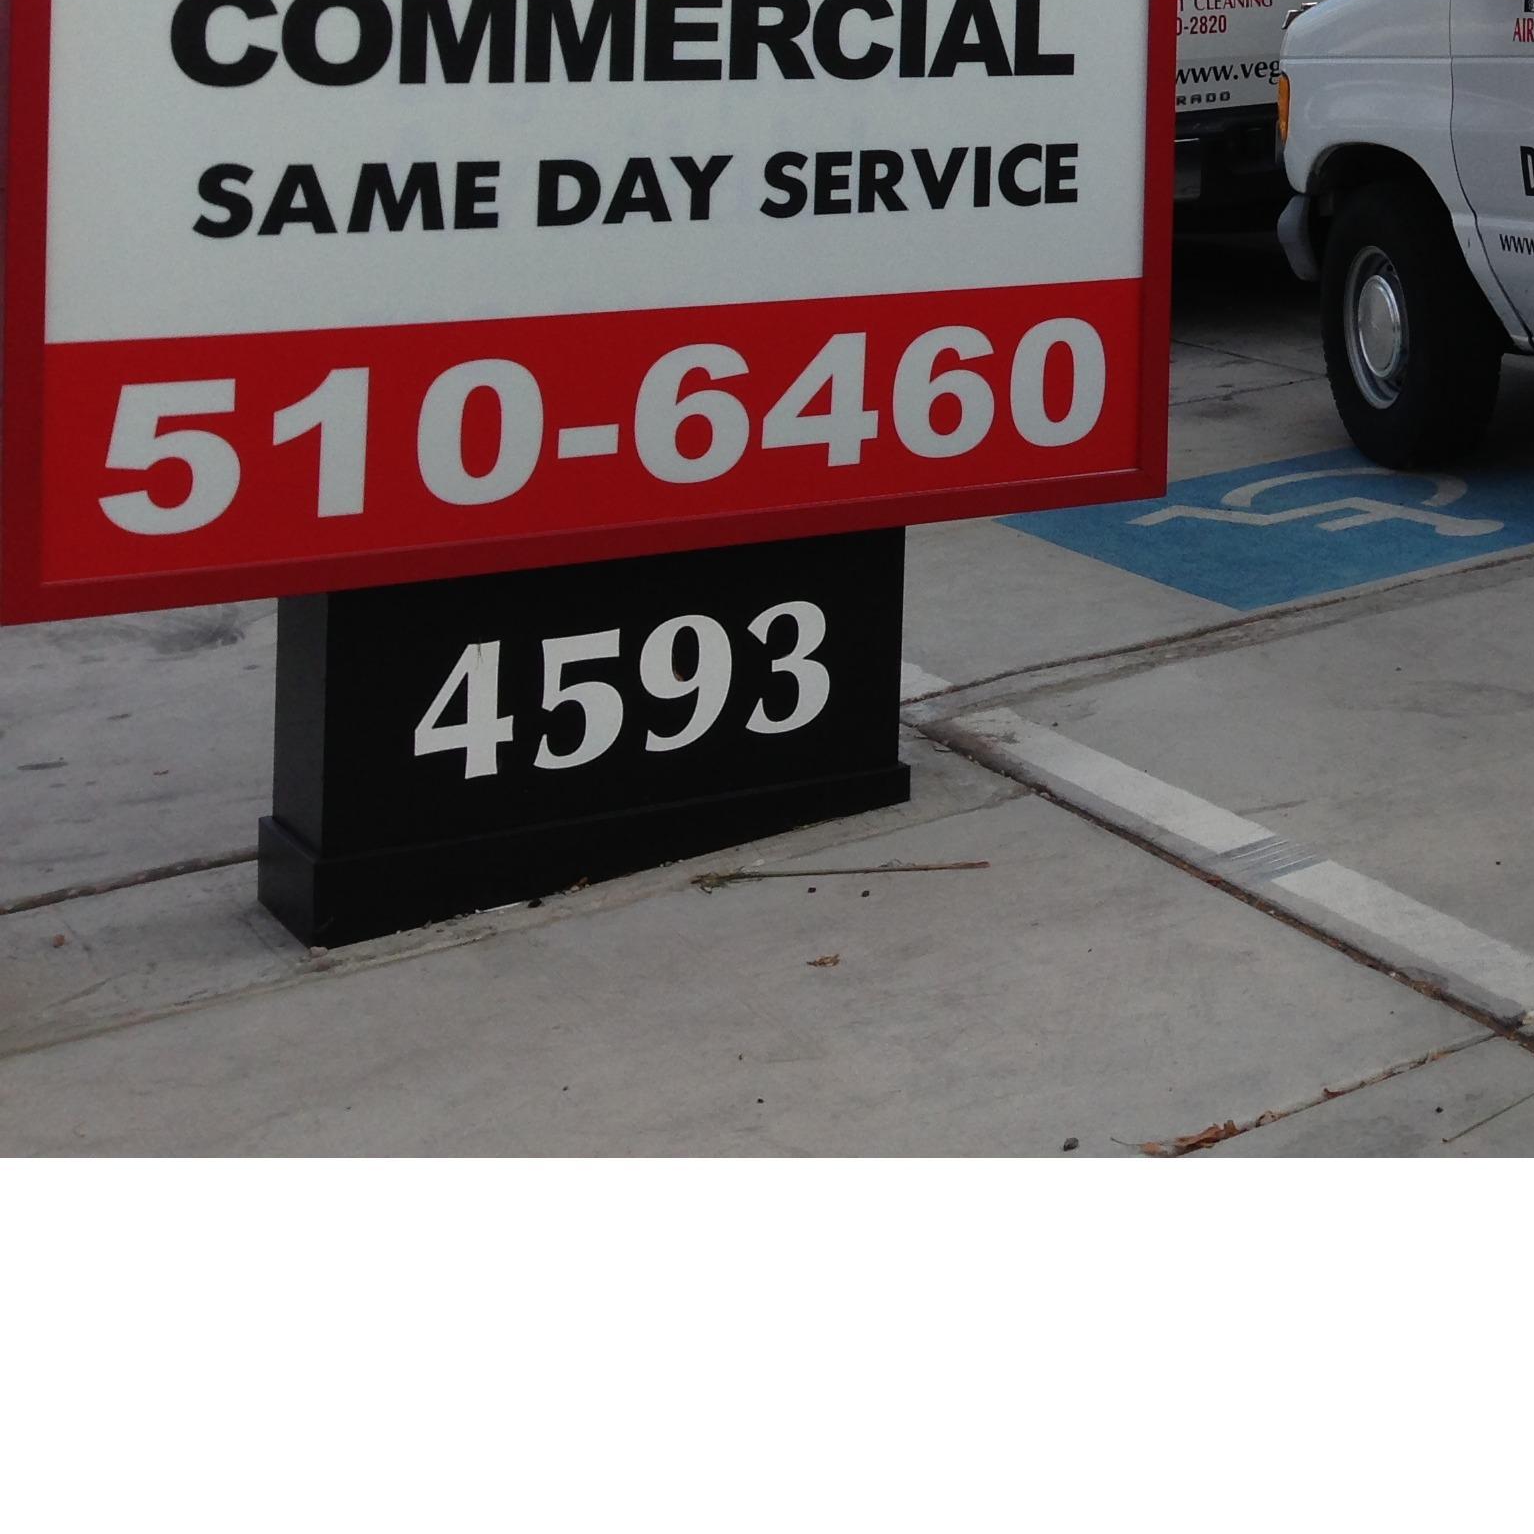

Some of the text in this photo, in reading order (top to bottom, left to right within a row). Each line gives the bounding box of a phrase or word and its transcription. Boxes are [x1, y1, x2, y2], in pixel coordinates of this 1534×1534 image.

[1513, 18, 1534, 43] AIR
[192, 143, 1078, 239] SAME DAY SERVICE
[98, 318, 1106, 536] 510-6460
[414, 601, 831, 780] 4593
